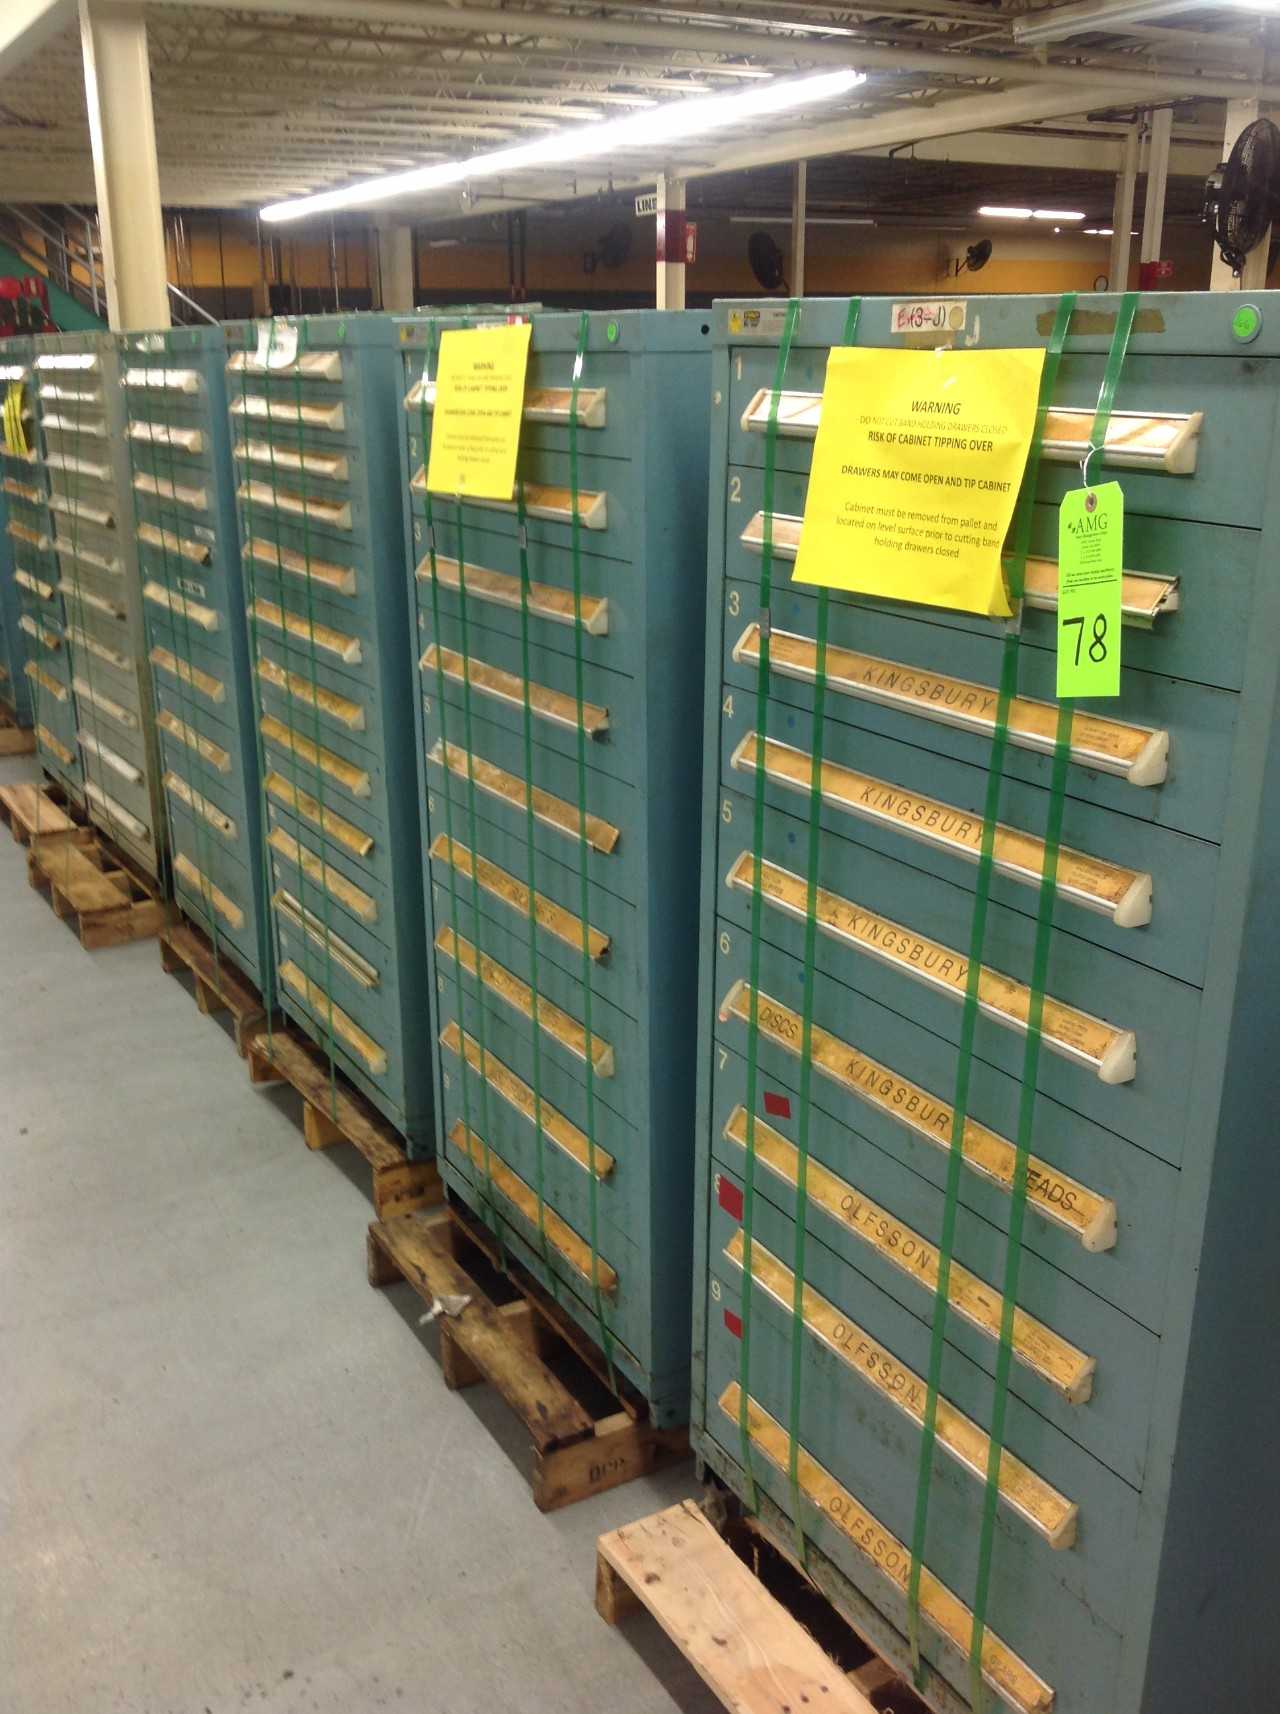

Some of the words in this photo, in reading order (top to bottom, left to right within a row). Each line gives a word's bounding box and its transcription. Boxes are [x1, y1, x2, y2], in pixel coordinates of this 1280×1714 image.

[736, 356, 742, 380] 1
[860, 416, 871, 425] DO
[911, 400, 961, 416] WARNING
[868, 431, 884, 442] RISK
[886, 432, 897, 444] OF
[898, 434, 932, 447] CABINET
[934, 436, 967, 450] TIPPING
[969, 440, 993, 452] OVER
[730, 476, 741, 502] 2
[842, 464, 880, 478] DRAWERS
[882, 469, 899, 480] MAY
[900, 471, 922, 482] COME
[923, 473, 944, 485] OPEN
[945, 476, 962, 487] AND
[964, 478, 976, 489] TIP
[978, 480, 1011, 493] CABINET
[845, 502, 874, 515] Cabinet
[876, 506, 896, 518] must
[897, 508, 906, 520] be
[907, 511, 939, 524] removed
[940, 514, 958, 527] from
[960, 516, 981, 531] pallet
[983, 520, 998, 532] and
[1076, 513, 1108, 534] AMG
[836, 516, 864, 529] located
[866, 520, 876, 530] on
[878, 522, 896, 534] level
[898, 525, 924, 538] surface
[925, 529, 944, 542] prior
[944, 530, 953, 542] to
[954, 532, 980, 548] cutting
[874, 536, 902, 552] holding
[904, 541, 934, 556] drawers
[935, 545, 960, 558] closed
[728, 591, 740, 616] 3
[1063, 613, 1107, 666] 78
[862, 666, 994, 713] KINGSBURY
[722, 695, 734, 718] 4
[722, 800, 732, 824] 5
[860, 785, 984, 844] KINGSBURY
[720, 932, 730, 954] 6
[848, 913, 968, 983] KINGSBURY
[718, 1047, 728, 1070] 7
[760, 1006, 798, 1040] DISCS
[846, 1058, 950, 1132] KINGSBUR
[1025, 1167, 1078, 1210] EADS
[840, 1194, 930, 1270] OLFSSON
[712, 1280, 720, 1300] 9
[832, 1322, 920, 1403] OLFSSON
[829, 1496, 910, 1583] OLFSSON
